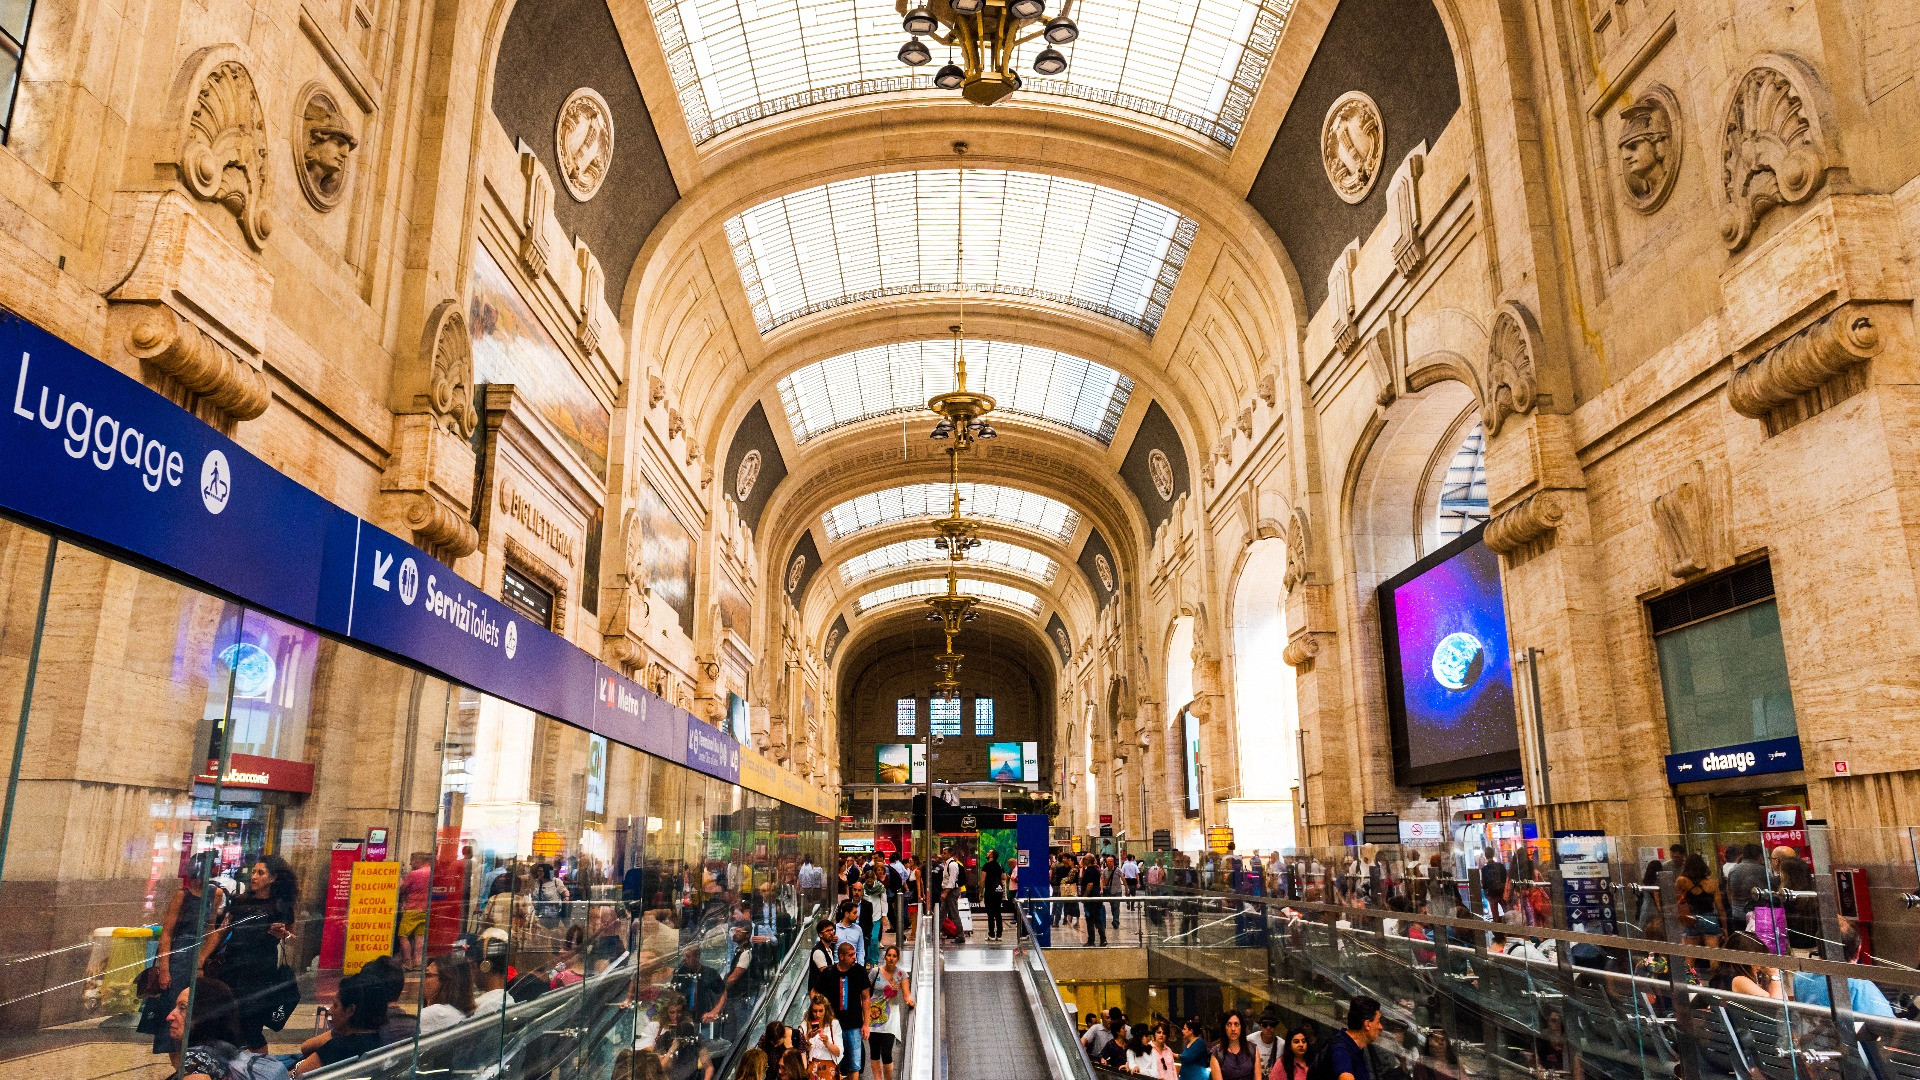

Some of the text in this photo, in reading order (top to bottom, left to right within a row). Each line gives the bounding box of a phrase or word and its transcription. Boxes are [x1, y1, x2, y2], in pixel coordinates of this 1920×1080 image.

[14, 352, 183, 492] Luggage
[510, 488, 568, 559] BIGLIETTERIA
[617, 684, 639, 716] Metro
[1702, 751, 1755, 772] change
[356, 868, 397, 876] TABACCHI
[354, 882, 396, 891] DOLCIUMI
[358, 897, 386, 905] ACQUA
[351, 907, 393, 915] MINERALE
[350, 922, 392, 930] SOUVENIR
[349, 934, 389, 942] ARTICOLI
[354, 943, 389, 952] REGALO
[346, 961, 364, 969] GIOC
